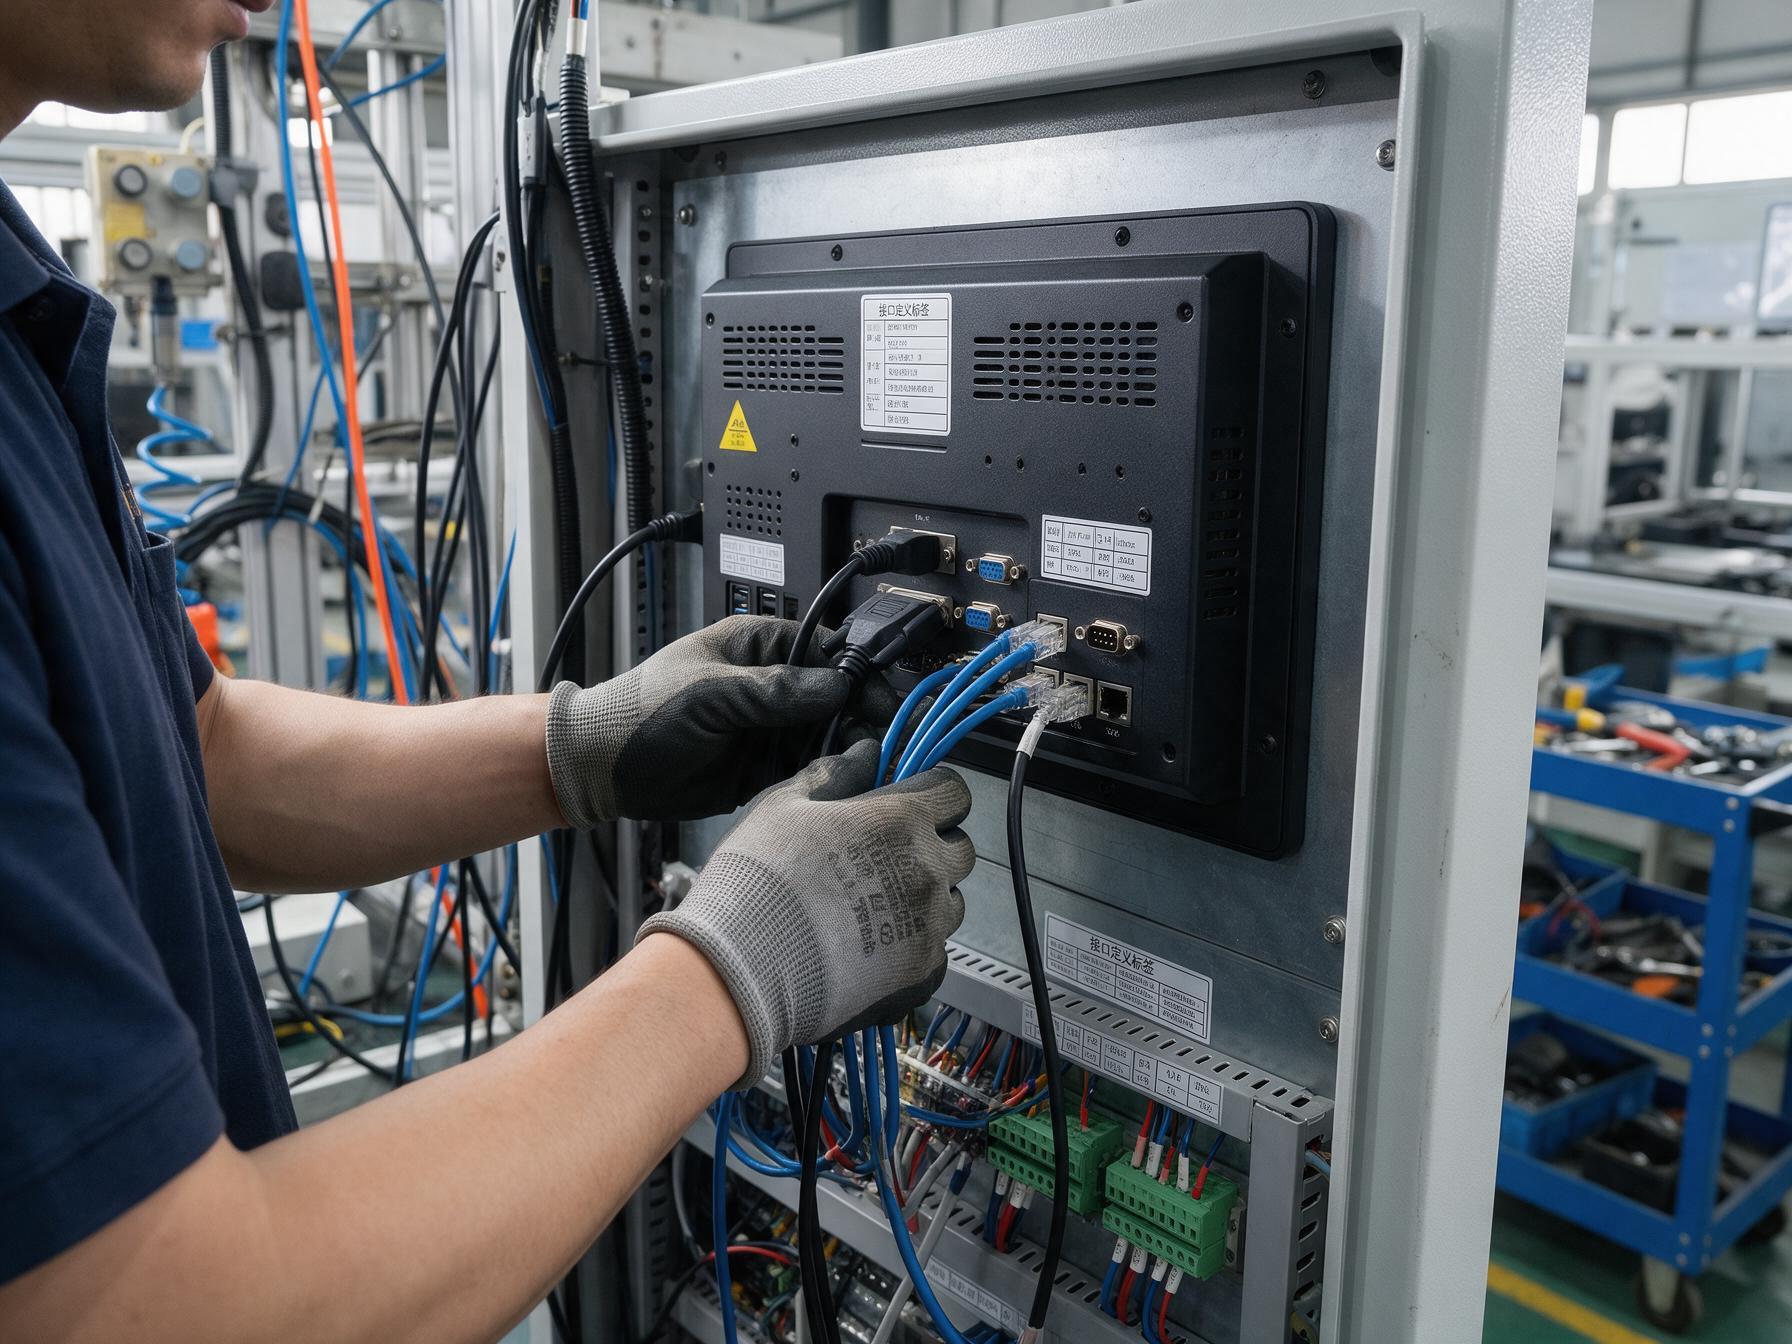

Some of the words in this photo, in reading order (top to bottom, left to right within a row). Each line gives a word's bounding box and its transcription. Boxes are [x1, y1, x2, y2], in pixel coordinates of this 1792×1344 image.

[879, 303, 930, 318] 接口定义标签
[1090, 936, 1155, 976] 接口定义标签
